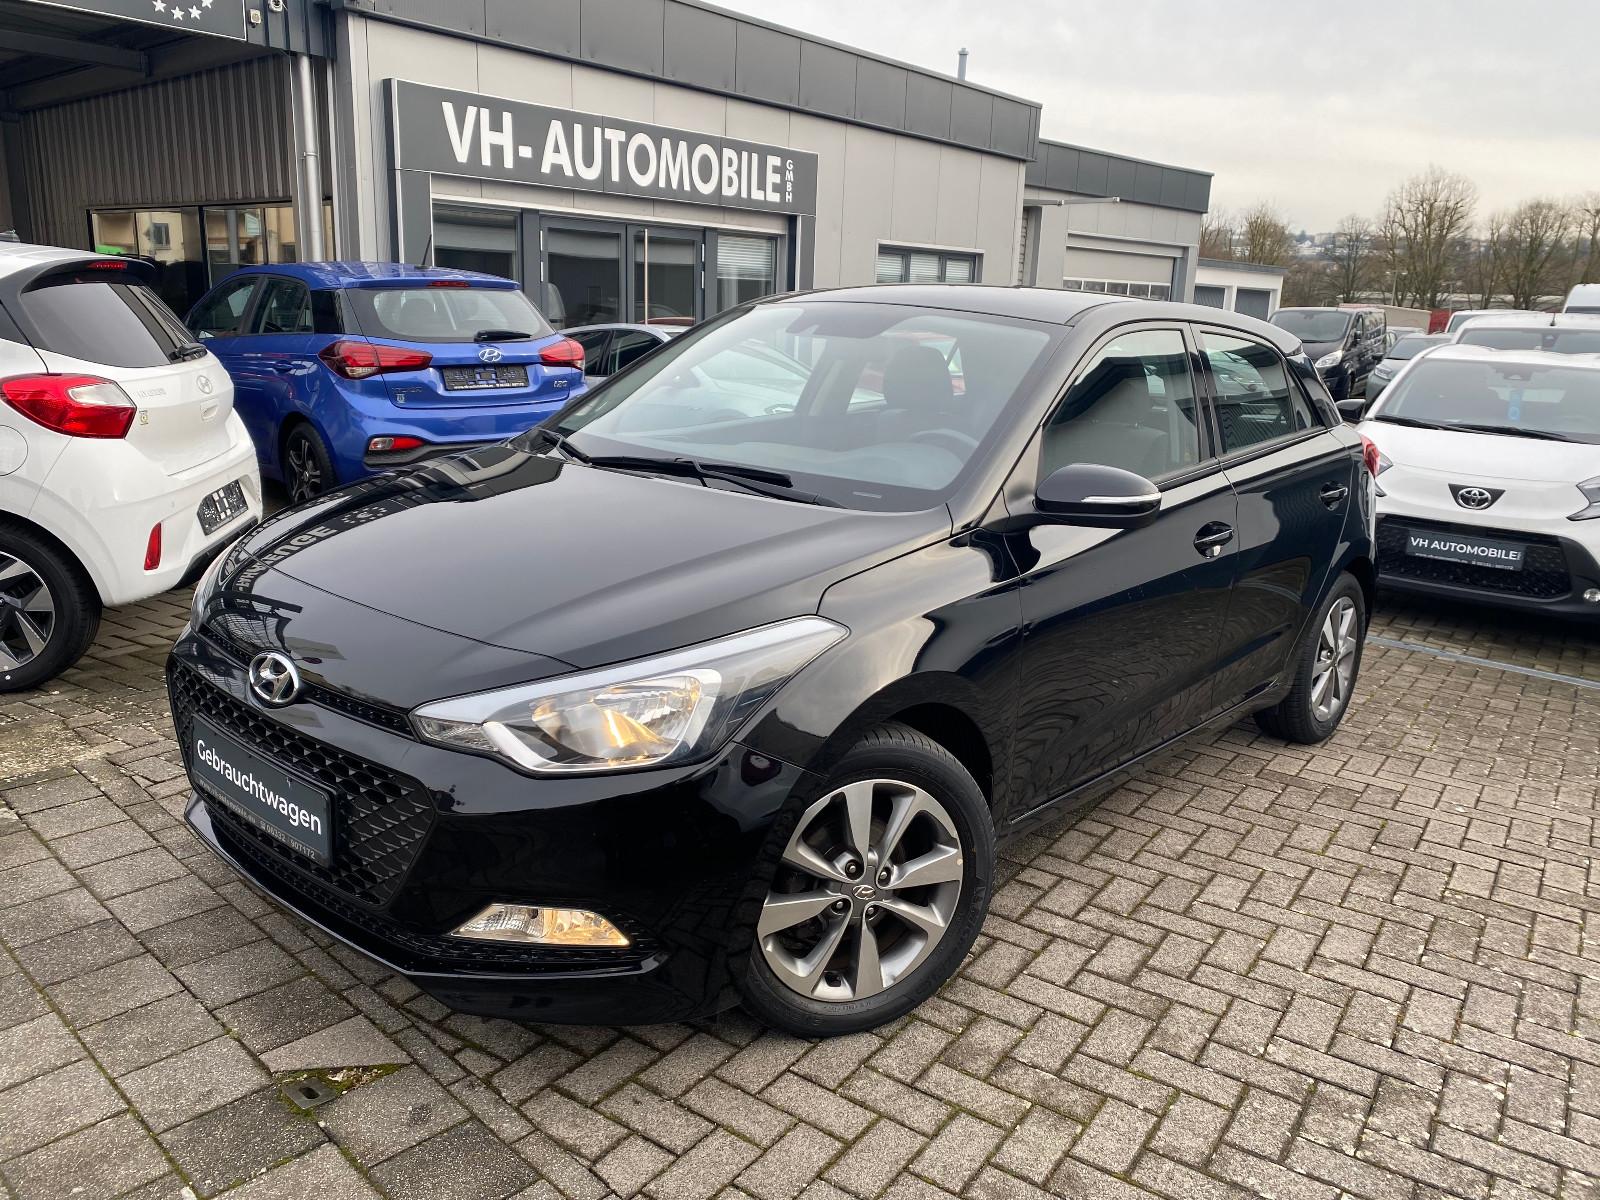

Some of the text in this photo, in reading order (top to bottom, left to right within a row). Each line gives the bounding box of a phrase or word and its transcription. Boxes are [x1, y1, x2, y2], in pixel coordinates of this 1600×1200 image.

[540, 118, 781, 203] AUTOMOBILE
[785, 159, 796, 203] GMBH
[1410, 536, 1428, 548] VH
[1430, 540, 1518, 560] AUTOMOBILE
[197, 739, 321, 835] Gebrauchtwagen
